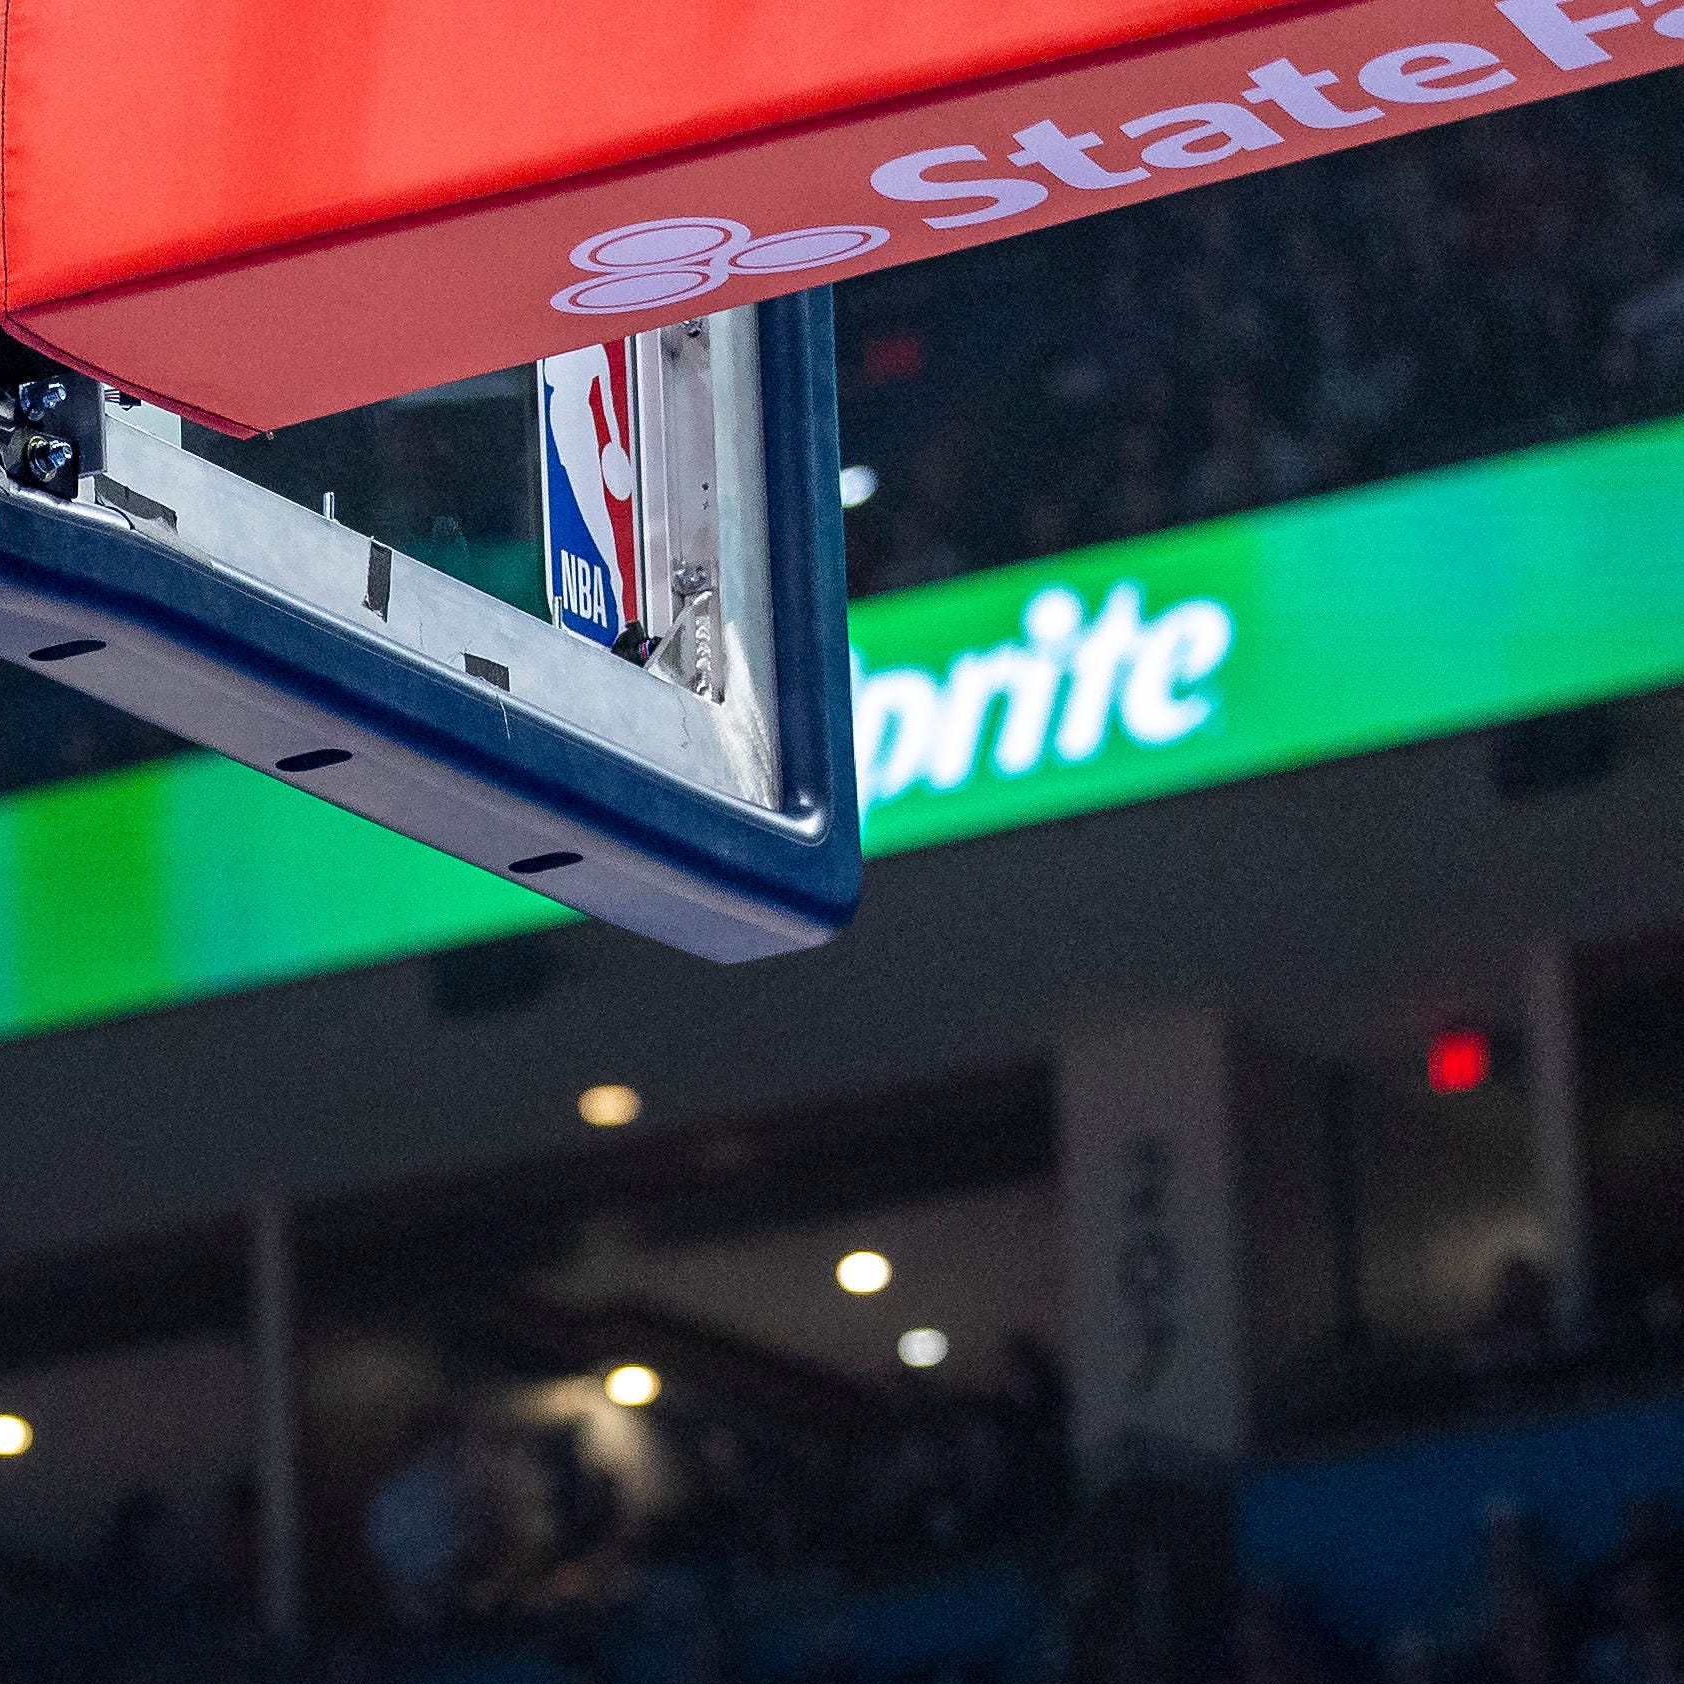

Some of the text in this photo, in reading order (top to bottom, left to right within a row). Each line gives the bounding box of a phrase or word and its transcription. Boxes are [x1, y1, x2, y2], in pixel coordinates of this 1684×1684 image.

[869, 41, 1519, 229] State
[560, 549, 608, 628] NBA
[850, 577, 1234, 822] prite
